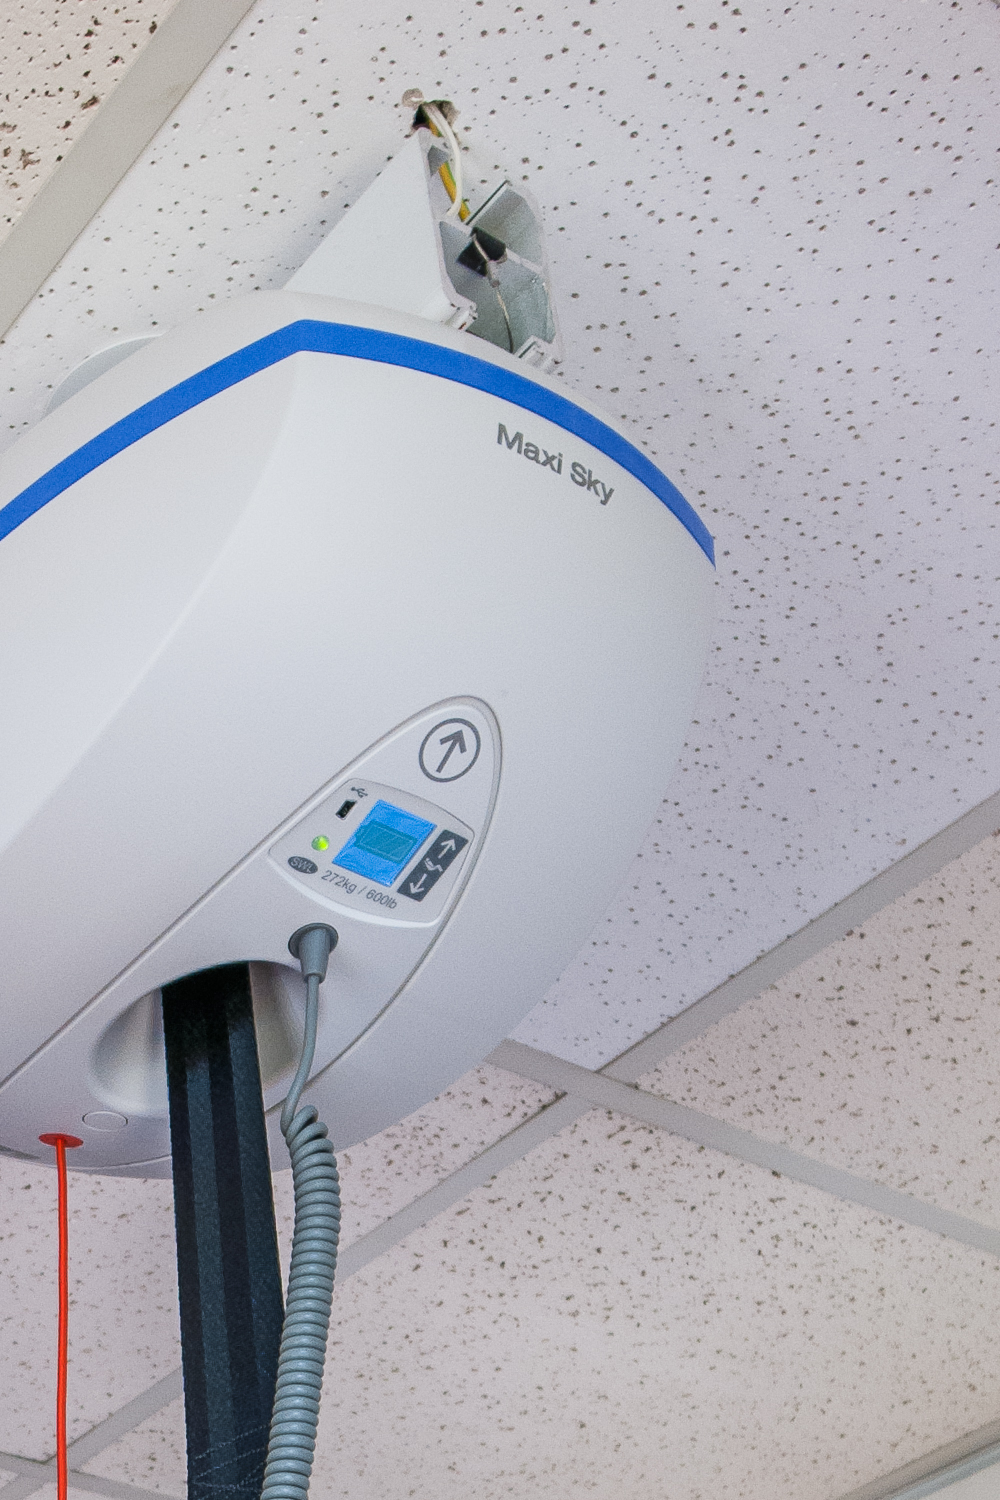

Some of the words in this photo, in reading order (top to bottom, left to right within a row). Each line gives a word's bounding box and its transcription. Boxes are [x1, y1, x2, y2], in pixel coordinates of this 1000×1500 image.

[496, 422, 563, 475] Maxi
[570, 461, 615, 506] Sky
[290, 856, 315, 874] SWL
[321, 869, 358, 894] 272kg
[366, 888, 398, 910] 600lb
